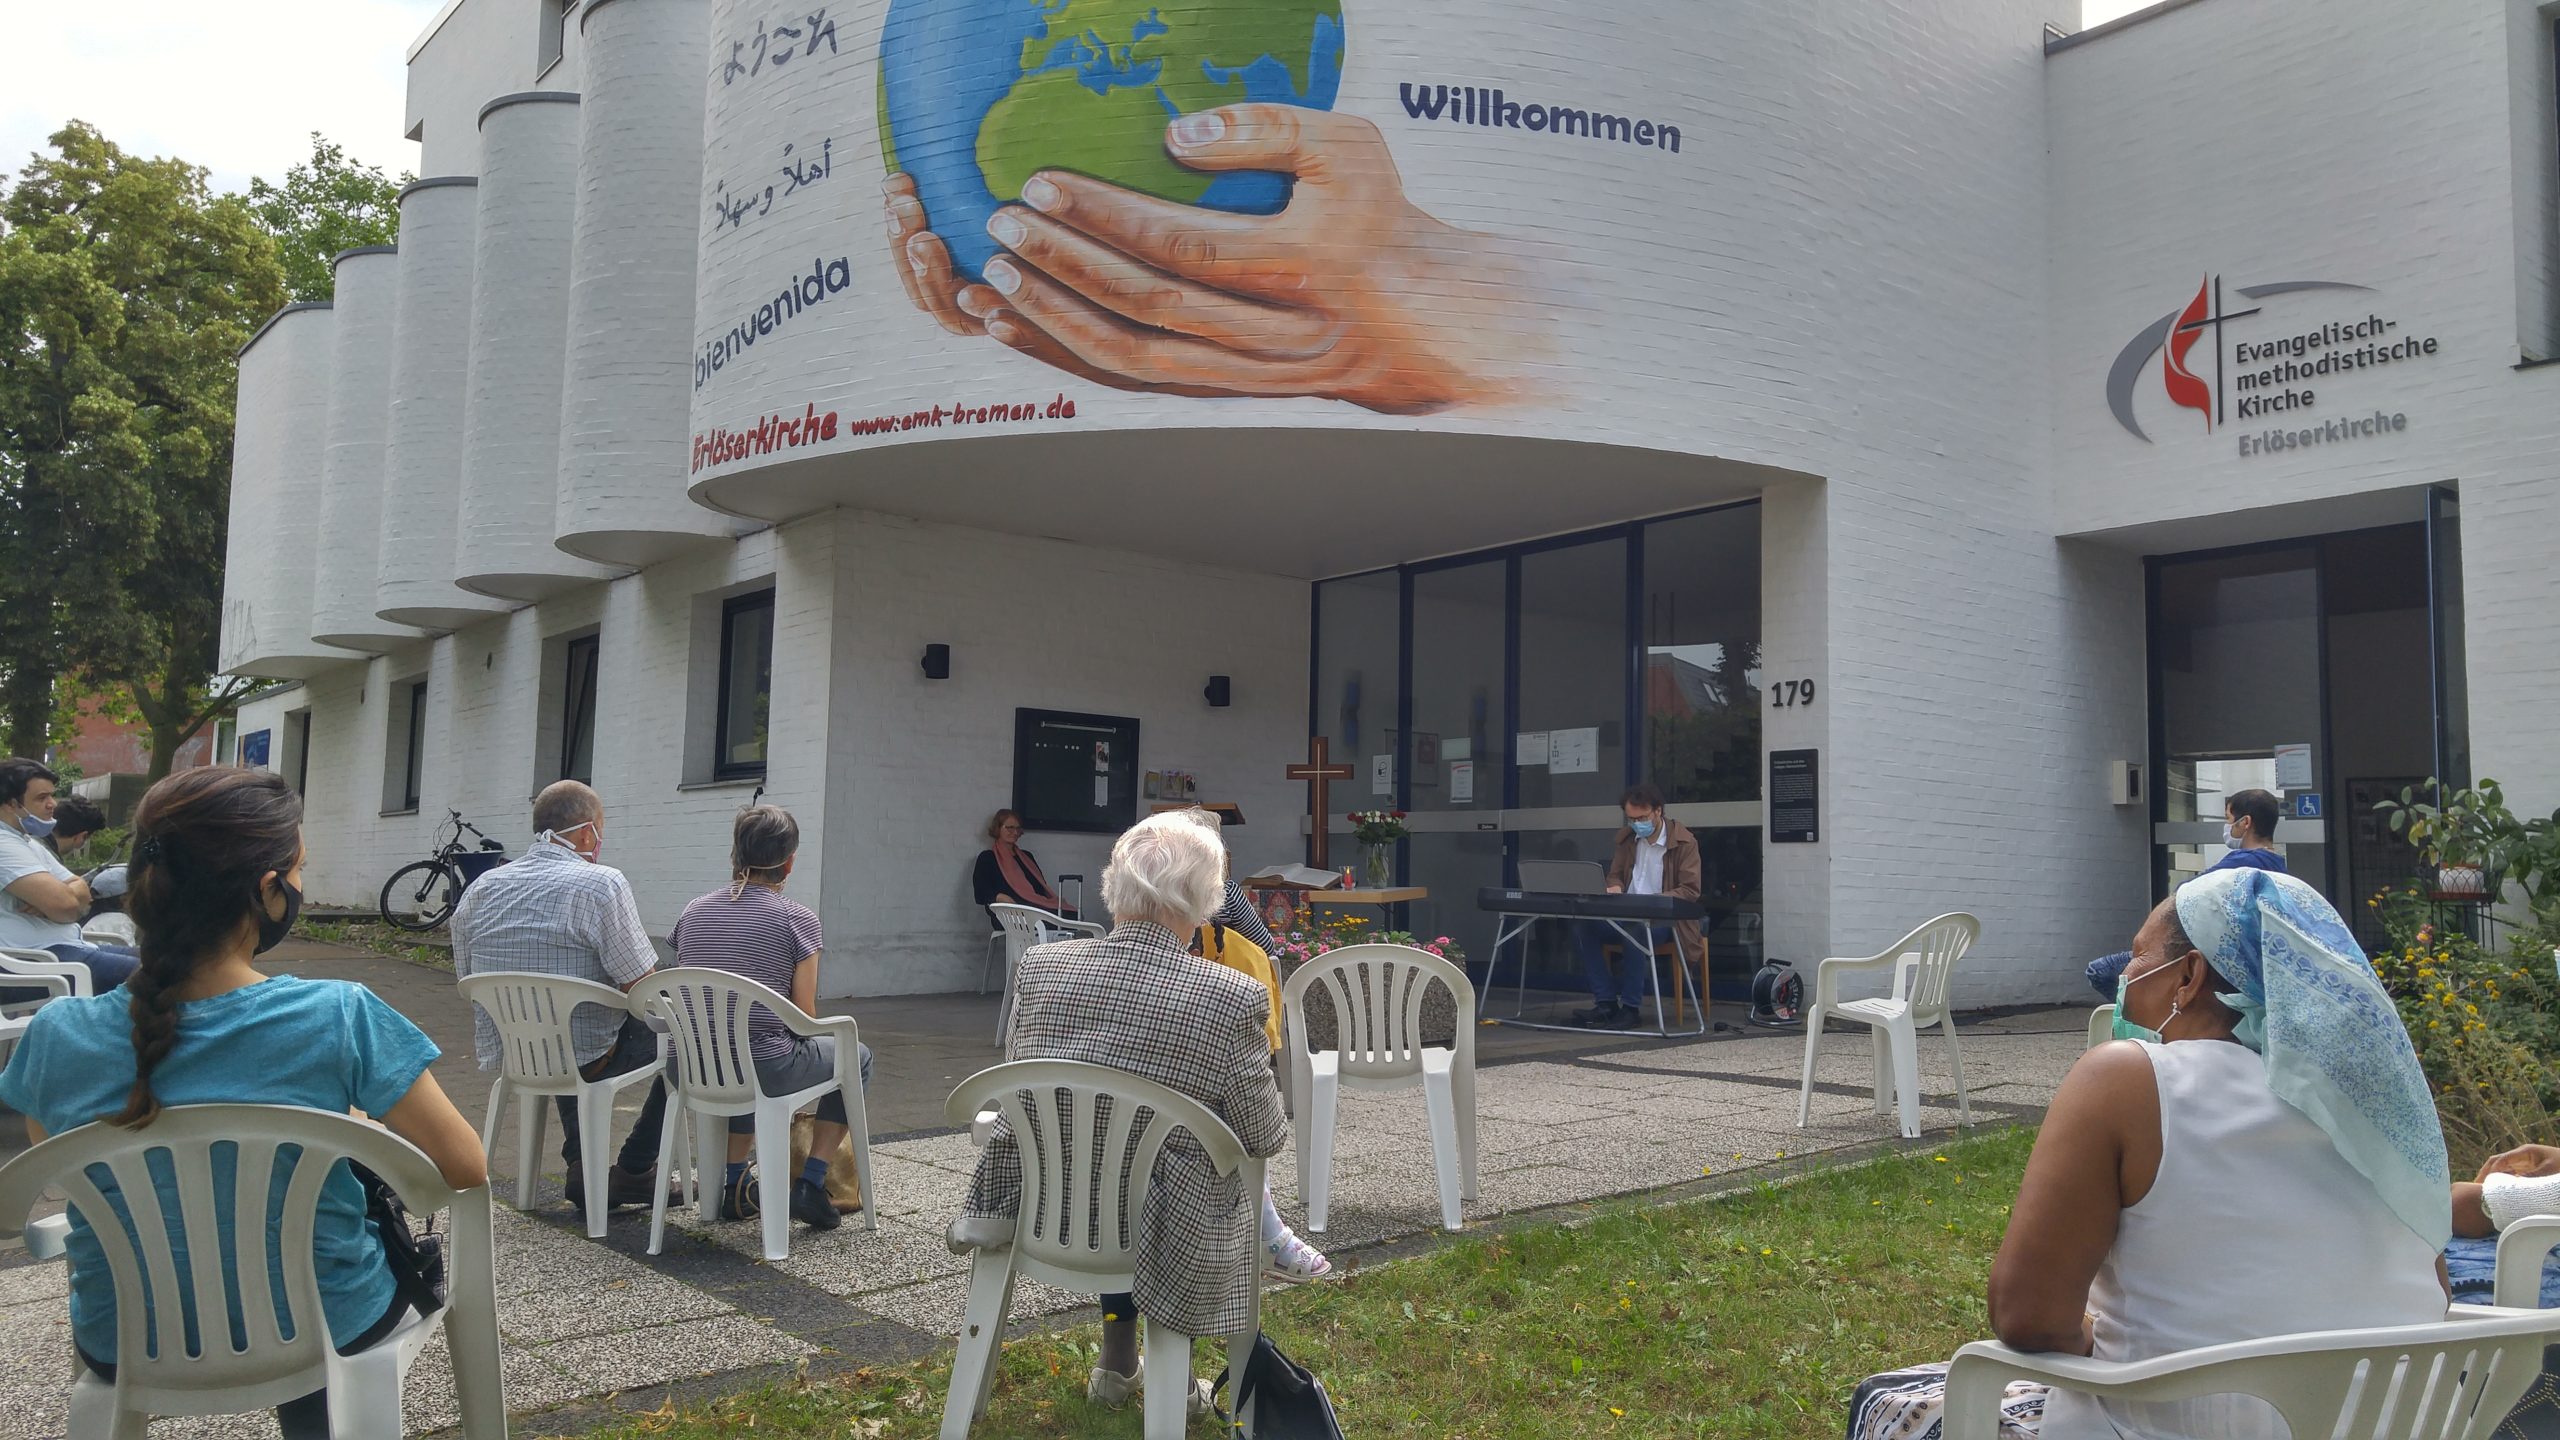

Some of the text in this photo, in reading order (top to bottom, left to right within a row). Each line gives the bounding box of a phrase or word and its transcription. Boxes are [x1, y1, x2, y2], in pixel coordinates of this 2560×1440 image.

[1400, 82, 1680, 153] Willkommen
[695, 256, 850, 392] bienvenida
[2236, 314, 2398, 364] Evangelisch-
[2236, 336, 2438, 391] methodistische
[2237, 388, 2315, 419] Kirche
[692, 402, 838, 474] Erlöserkirche
[2238, 410, 2407, 457] Erlöserkirche
[1771, 679, 1815, 708] 179
